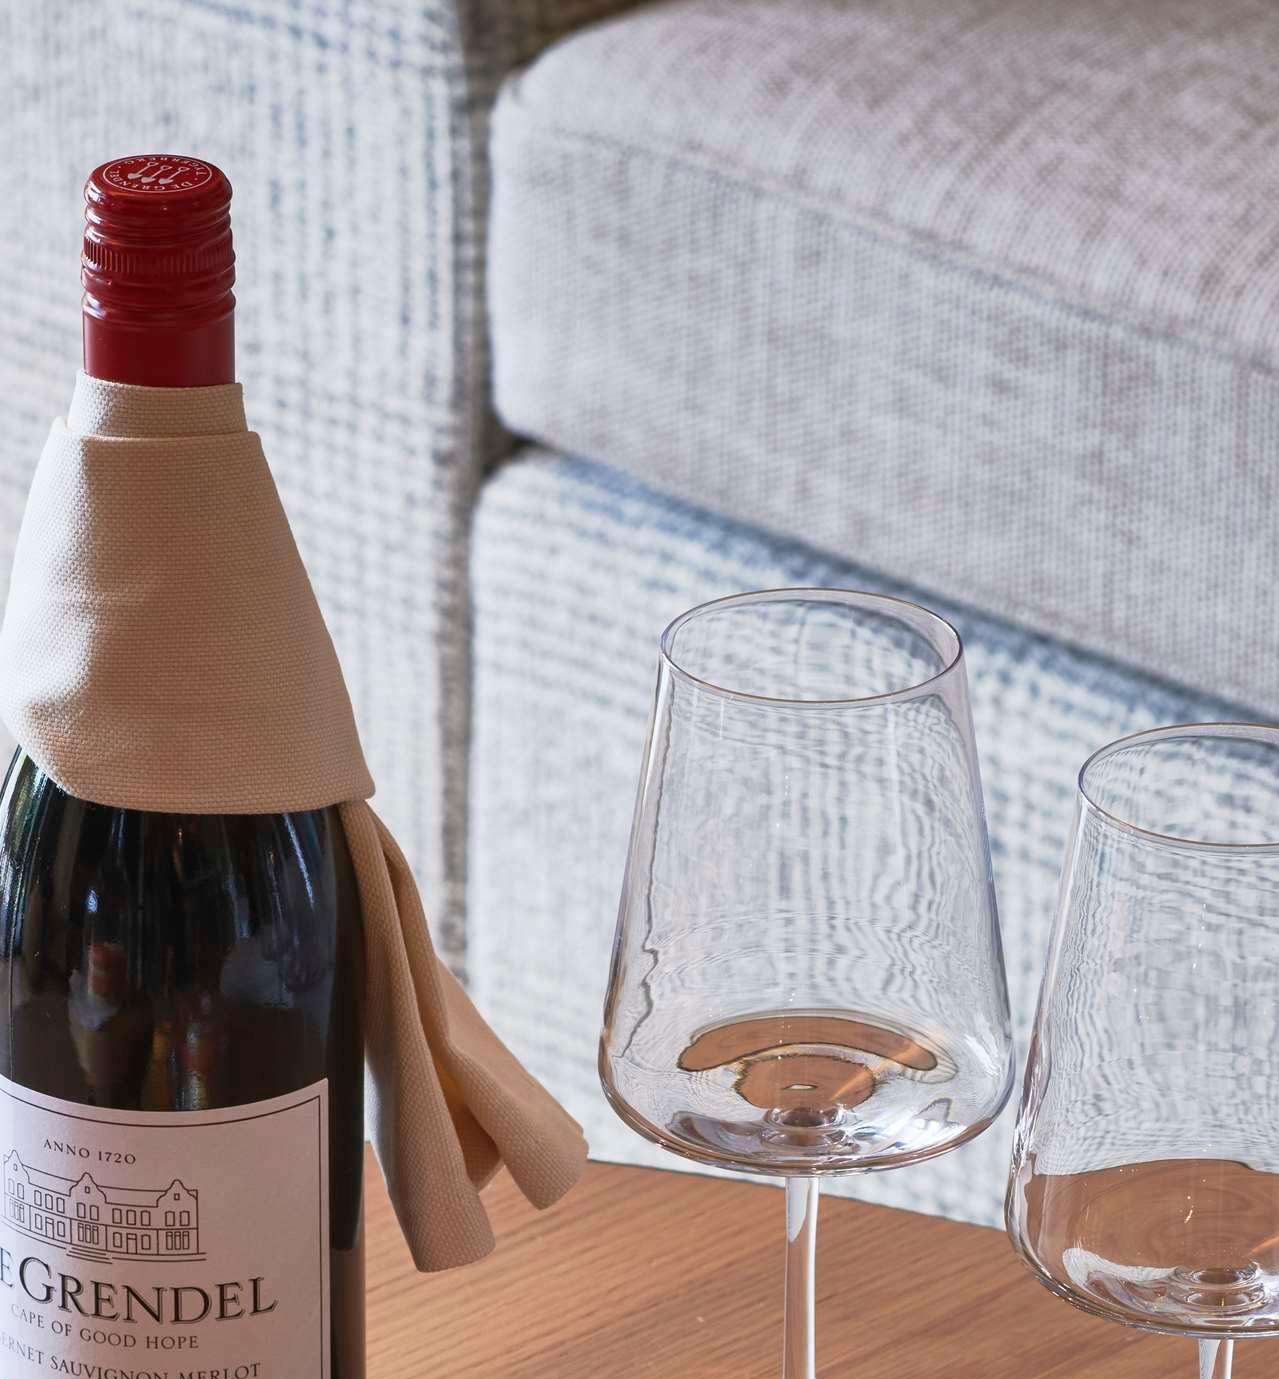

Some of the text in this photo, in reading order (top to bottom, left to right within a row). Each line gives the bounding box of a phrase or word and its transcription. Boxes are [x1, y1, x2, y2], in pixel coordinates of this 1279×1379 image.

[44, 1139, 137, 1165] ANNO 1720
[19, 1256, 280, 1325] GRENDEL
[10, 1303, 200, 1350] CAPE OF GOOD HOPE
